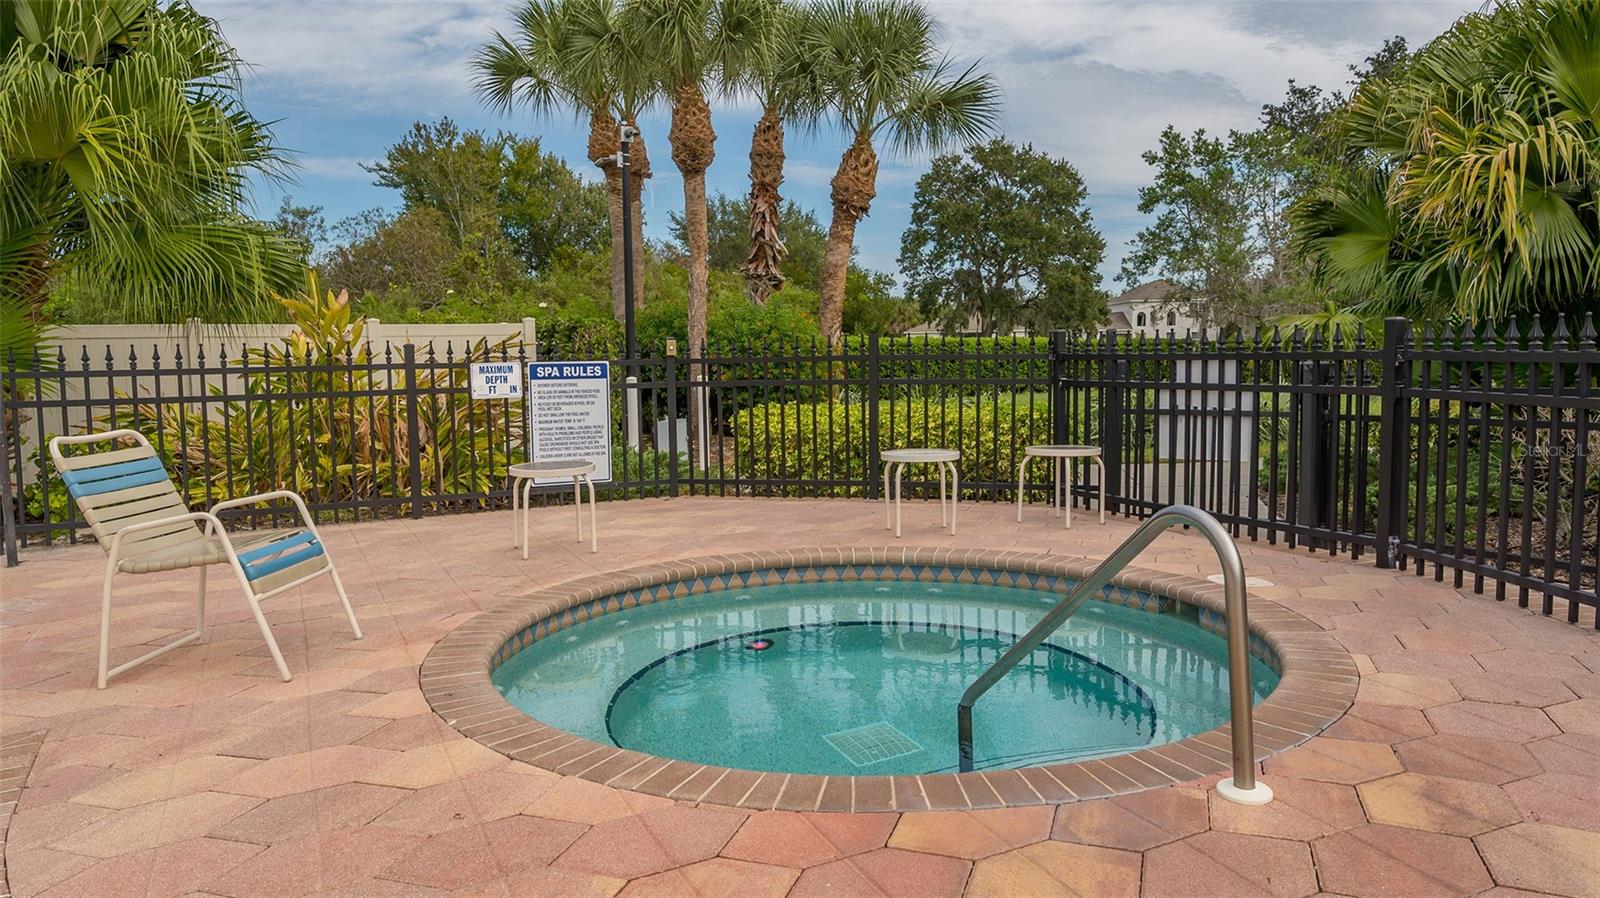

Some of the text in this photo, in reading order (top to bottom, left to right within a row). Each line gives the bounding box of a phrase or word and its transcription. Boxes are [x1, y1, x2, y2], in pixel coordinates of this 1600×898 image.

[479, 365, 513, 374] MAXIMUM
[536, 366, 602, 377] SPA RULES
[486, 376, 508, 384] DEPTH
[489, 385, 518, 394] FT IN
